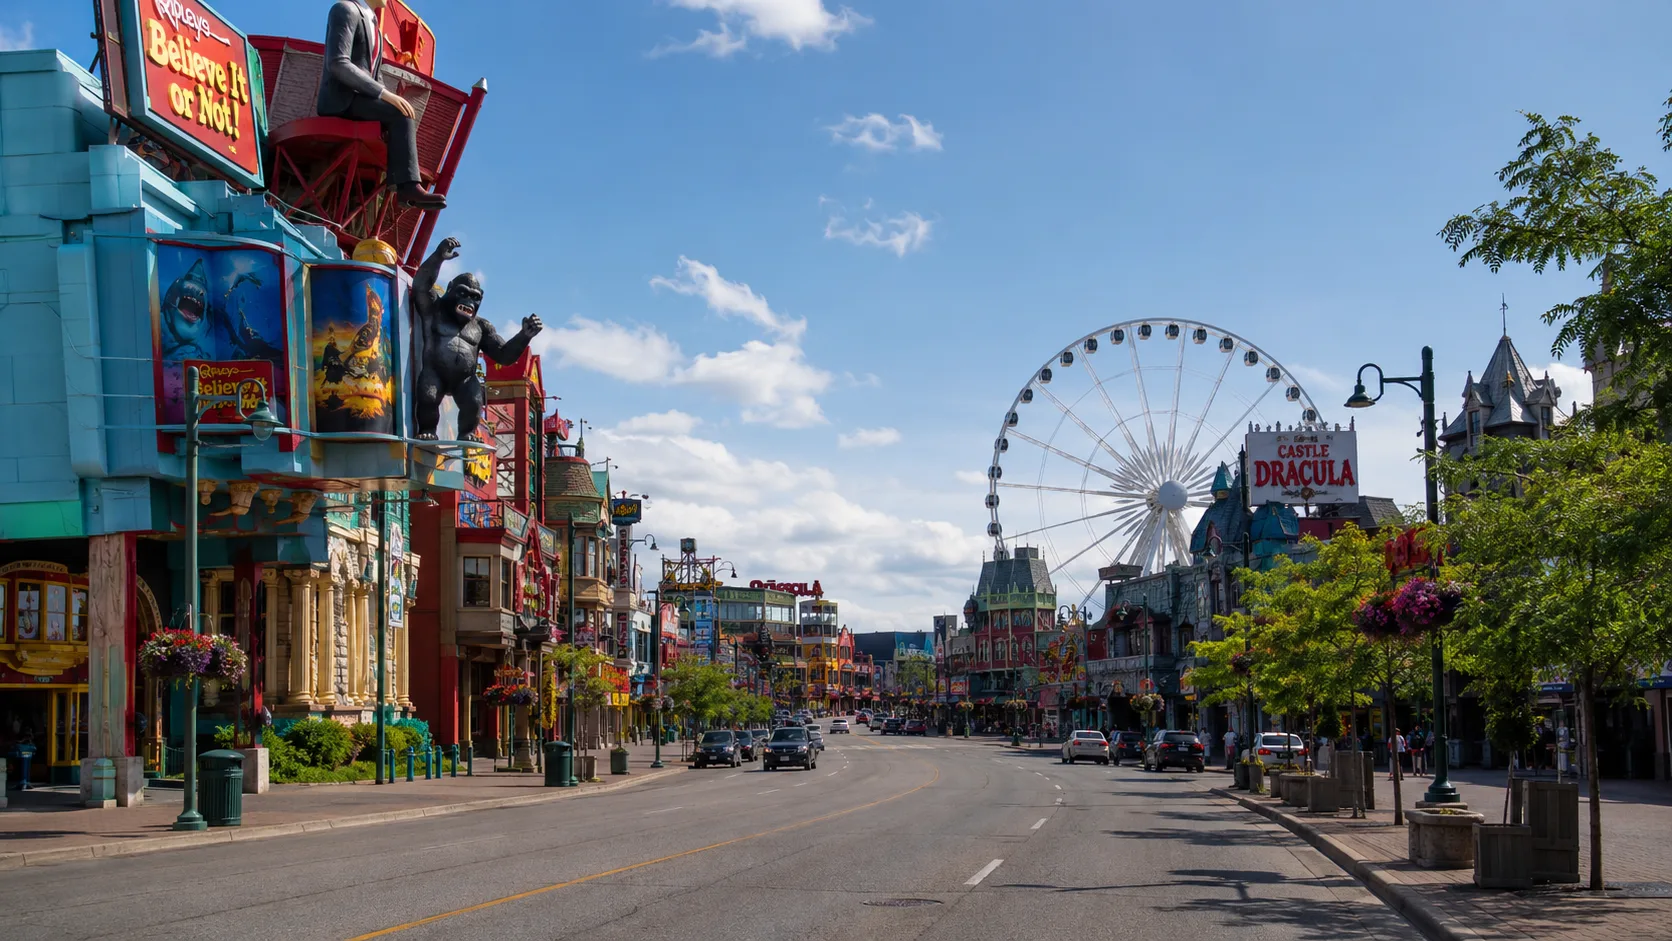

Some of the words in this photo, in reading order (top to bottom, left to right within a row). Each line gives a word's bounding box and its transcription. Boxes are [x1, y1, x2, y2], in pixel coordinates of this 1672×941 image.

[147, 18, 227, 94] Believe
[228, 61, 248, 104] It
[169, 83, 195, 120] or
[195, 84, 241, 141] Not!
[1278, 444, 1329, 459] CASTLE
[1254, 459, 1356, 488] DRACULA
